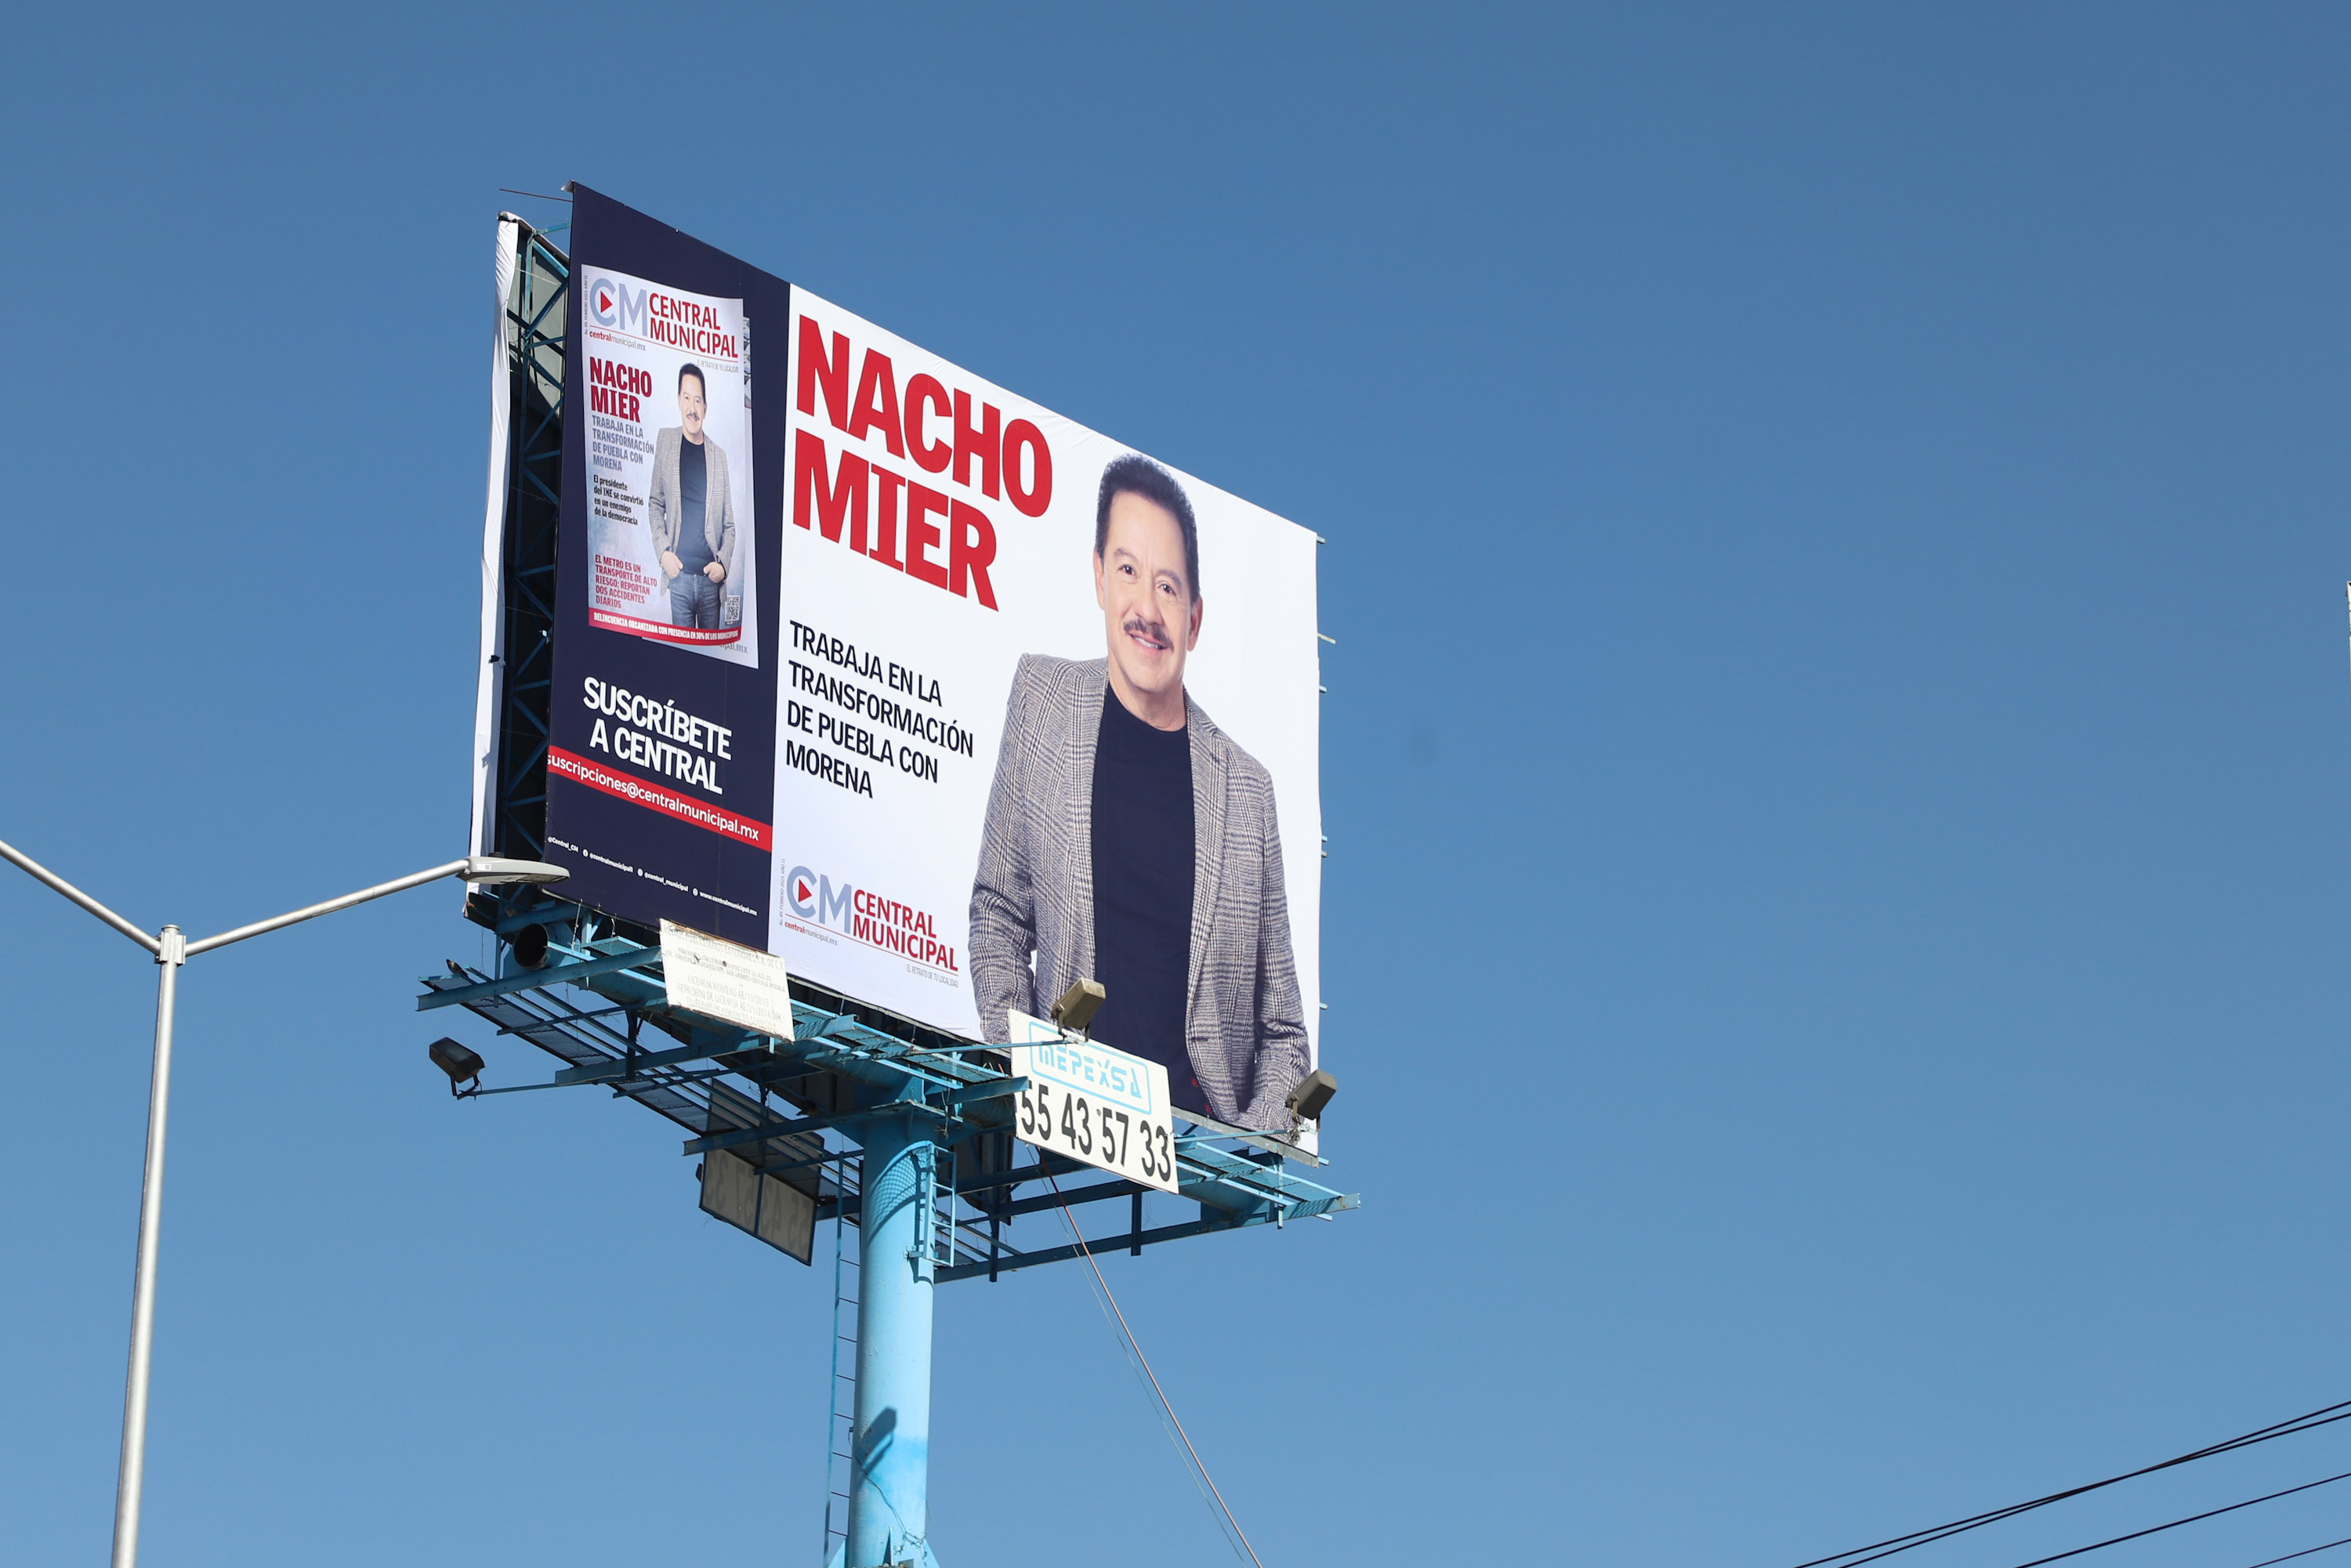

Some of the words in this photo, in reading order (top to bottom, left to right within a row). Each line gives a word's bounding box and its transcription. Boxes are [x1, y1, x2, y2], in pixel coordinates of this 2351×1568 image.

[589, 277, 648, 337] CM
[649, 292, 721, 331] CENTRAL
[589, 330, 646, 351] centralmunicipal.mx
[650, 317, 738, 358] MUNICIPAL
[589, 357, 652, 398] NACHO
[591, 386, 640, 423] MIER
[796, 314, 1052, 517] NACHO
[592, 415, 624, 433] TRABAJA
[625, 424, 634, 436] EN
[636, 427, 643, 439] LA
[592, 428, 654, 454] TRANSFORMACIÓN
[592, 441, 602, 454] DE
[603, 444, 629, 461] PUEBLA
[629, 451, 643, 465] CON
[593, 454, 622, 472] MORENA
[593, 474, 599, 483] El
[600, 476, 628, 491] presidente
[594, 486, 603, 495] del
[603, 487, 612, 498] INE
[614, 491, 619, 500] se
[621, 492, 643, 506] convirtió
[594, 497, 601, 505] en
[602, 498, 608, 507] un
[610, 500, 632, 514] enemigo
[595, 506, 601, 516] de
[602, 508, 607, 517] la
[608, 510, 638, 526] democracia
[793, 427, 999, 612] MIER
[596, 554, 603, 564] EL
[603, 557, 624, 569] METRO
[625, 561, 632, 570] ES
[633, 563, 641, 573] UN
[596, 564, 633, 581] TRANSPORTE
[635, 574, 642, 583] DE
[643, 576, 657, 587] ALTO
[596, 576, 620, 589] RIESGO;
[621, 581, 650, 596] REPORTAN
[596, 585, 607, 596] DOS
[609, 587, 645, 604] ACCIDENTES
[596, 596, 621, 609] DIARIOS
[593, 612, 628, 628] DELINCUENCIA
[629, 619, 658, 634] ORGANIZADA
[658, 626, 668, 636] CON
[668, 628, 690, 639] PRESENCIA
[690, 631, 696, 639] EN
[696, 631, 705, 640] 30%
[705, 632, 710, 640] DE
[790, 620, 883, 683] TRABAJA
[889, 661, 913, 696] EN
[918, 674, 943, 708] LA
[583, 676, 732, 760] SUSCRÍBETE
[788, 659, 973, 759] TRANSFORMACIÓN
[589, 718, 610, 753] A
[614, 727, 723, 795] CENTRAL
[788, 700, 813, 734] DE
[818, 712, 894, 767] PUEBLA
[899, 746, 938, 784] CON
[786, 739, 873, 799] MORENA
[547, 754, 759, 842] suscripciones@centralmunicipal.mx
[699, 891, 758, 916] www.centralmunicipal.mx
[786, 865, 852, 934] CM
[854, 889, 937, 940] CENTRAL
[784, 921, 838, 947] centralmunicipal.mx
[853, 914, 958, 972] MUNICIPAL
[911, 966, 929, 979] RETRATO
[939, 974, 958, 988] LOCALIDAD
[1021, 1081, 1052, 1141] 55
[1061, 1092, 1092, 1156] 43
[1102, 1107, 1129, 1168] 57
[1139, 1120, 1171, 1182] 33
